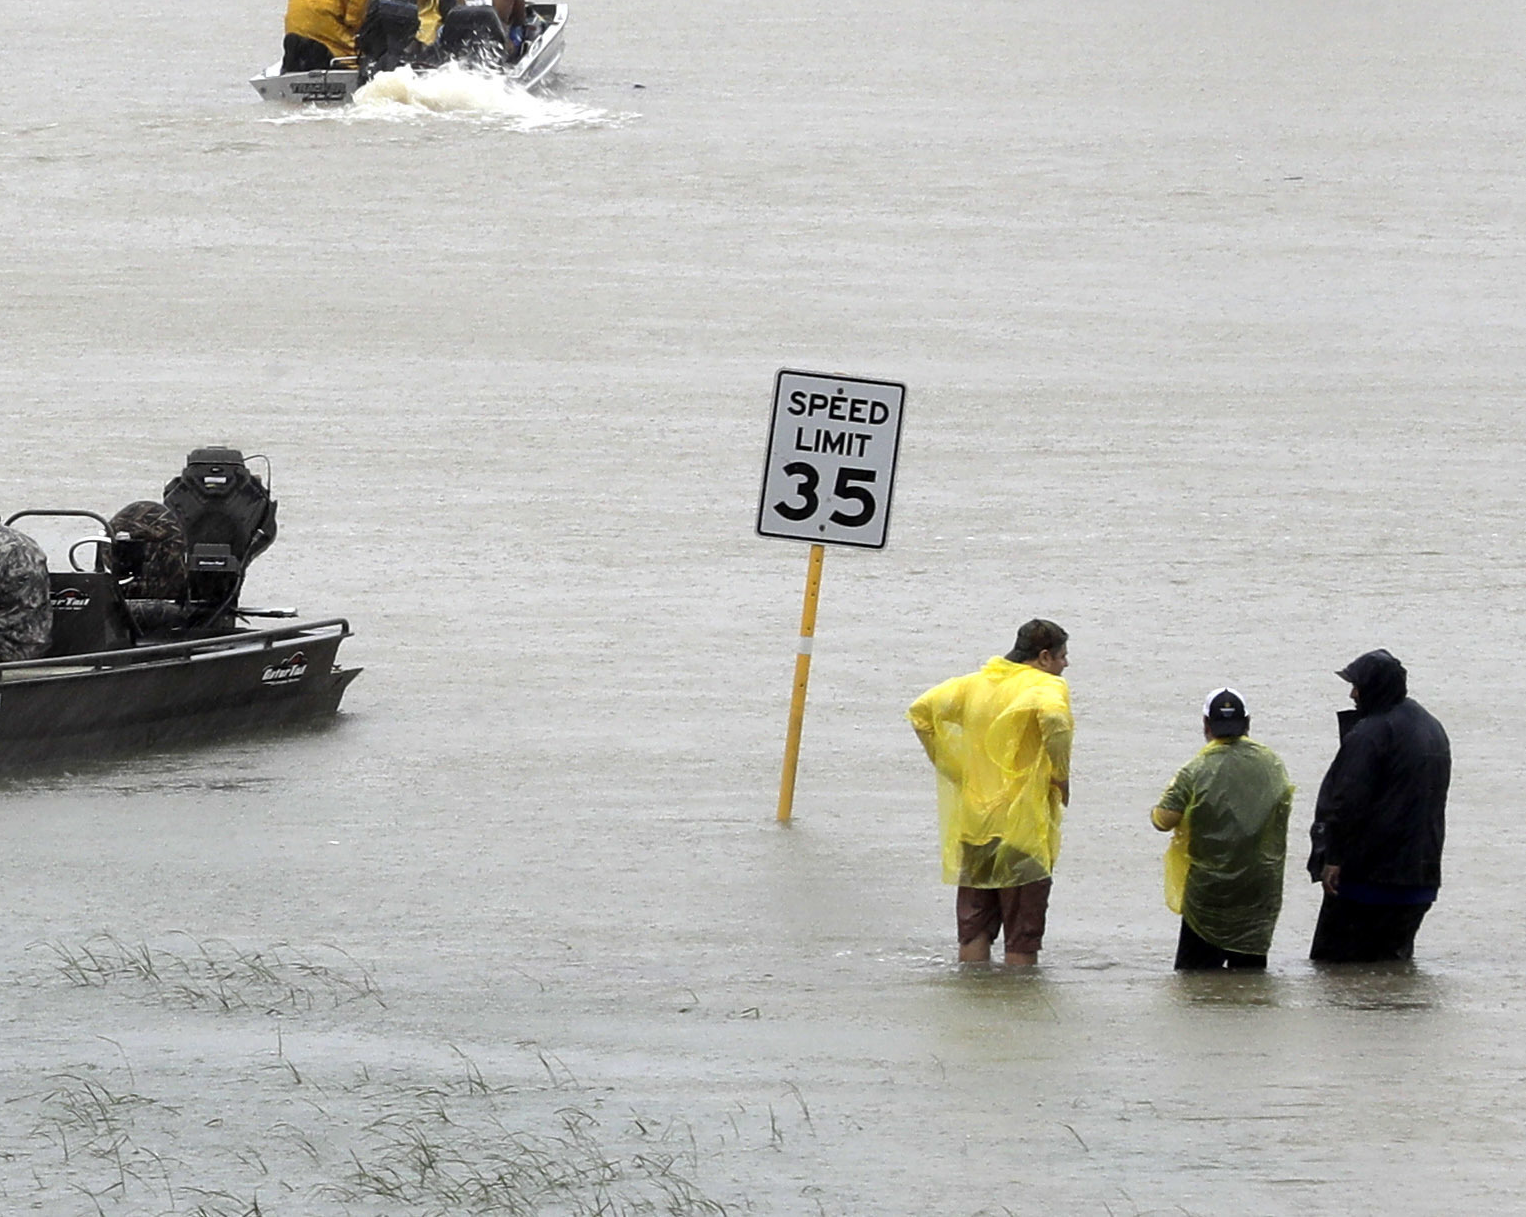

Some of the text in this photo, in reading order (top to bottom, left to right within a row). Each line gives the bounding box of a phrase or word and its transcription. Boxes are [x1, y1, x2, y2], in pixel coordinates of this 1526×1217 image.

[787, 390, 889, 425] SPEED
[795, 427, 873, 458] LIMIT
[773, 462, 877, 527] 35
